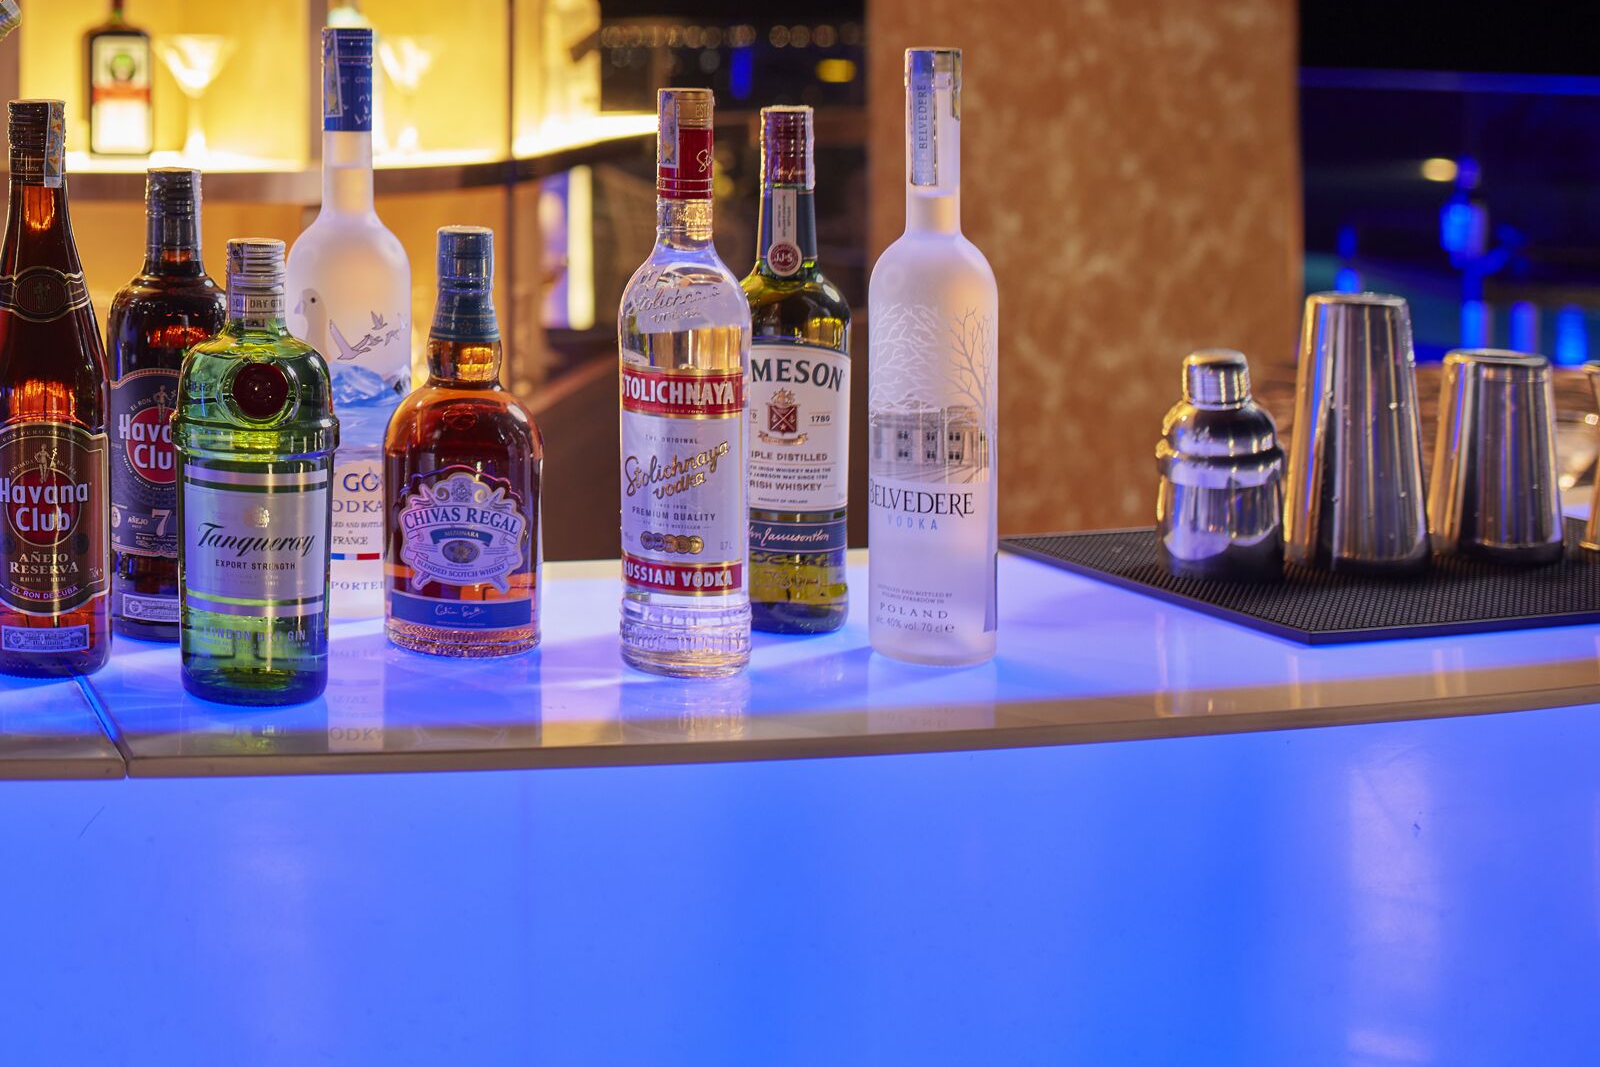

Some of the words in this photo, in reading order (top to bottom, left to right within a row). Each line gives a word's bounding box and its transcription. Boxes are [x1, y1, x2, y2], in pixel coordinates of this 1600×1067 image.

[917, 85, 928, 150] BELVEDERE
[250, 299, 268, 308] DRY
[751, 358, 843, 392] MESON
[623, 375, 736, 406] TOLICHNAYA
[118, 414, 172, 443] Hava
[661, 436, 699, 444] ORIGINAL
[134, 444, 172, 470] Clu
[751, 450, 773, 460] IPLE
[777, 453, 828, 462] DISTILLED
[625, 441, 729, 496] Stolichnaya
[653, 472, 706, 499] vodka
[749, 480, 772, 489] RISH
[776, 482, 822, 491] WHISKEY
[332, 500, 384, 513] ODKA
[869, 479, 975, 518] BELVEDERE
[15, 507, 71, 531] Club
[404, 508, 461, 529] CHIVAS
[466, 508, 518, 535] REGAL
[632, 506, 669, 519] PREMIUM
[674, 513, 716, 522] QUALITY
[888, 514, 938, 530] VODKA
[151, 509, 172, 536] 7
[197, 523, 316, 557] Tanqueray
[333, 536, 369, 545] FRANCE
[20, 551, 68, 562] AÑEJO
[216, 559, 247, 569] EXPORT
[10, 562, 79, 574] RESERVA
[416, 559, 447, 576] BLENDED
[448, 570, 479, 578] SCOTCH
[479, 563, 507, 576] WHISKY
[331, 581, 384, 591] PORTE
[682, 570, 733, 587] VODKA
[11, 585, 20, 593] EL
[23, 590, 40, 599] RON
[57, 585, 79, 598] CUBA
[880, 602, 948, 619] POLAND
[203, 626, 250, 640] LONDON
[287, 629, 306, 641] GIN
[921, 622, 933, 632] 70
[935, 624, 943, 633] cl
